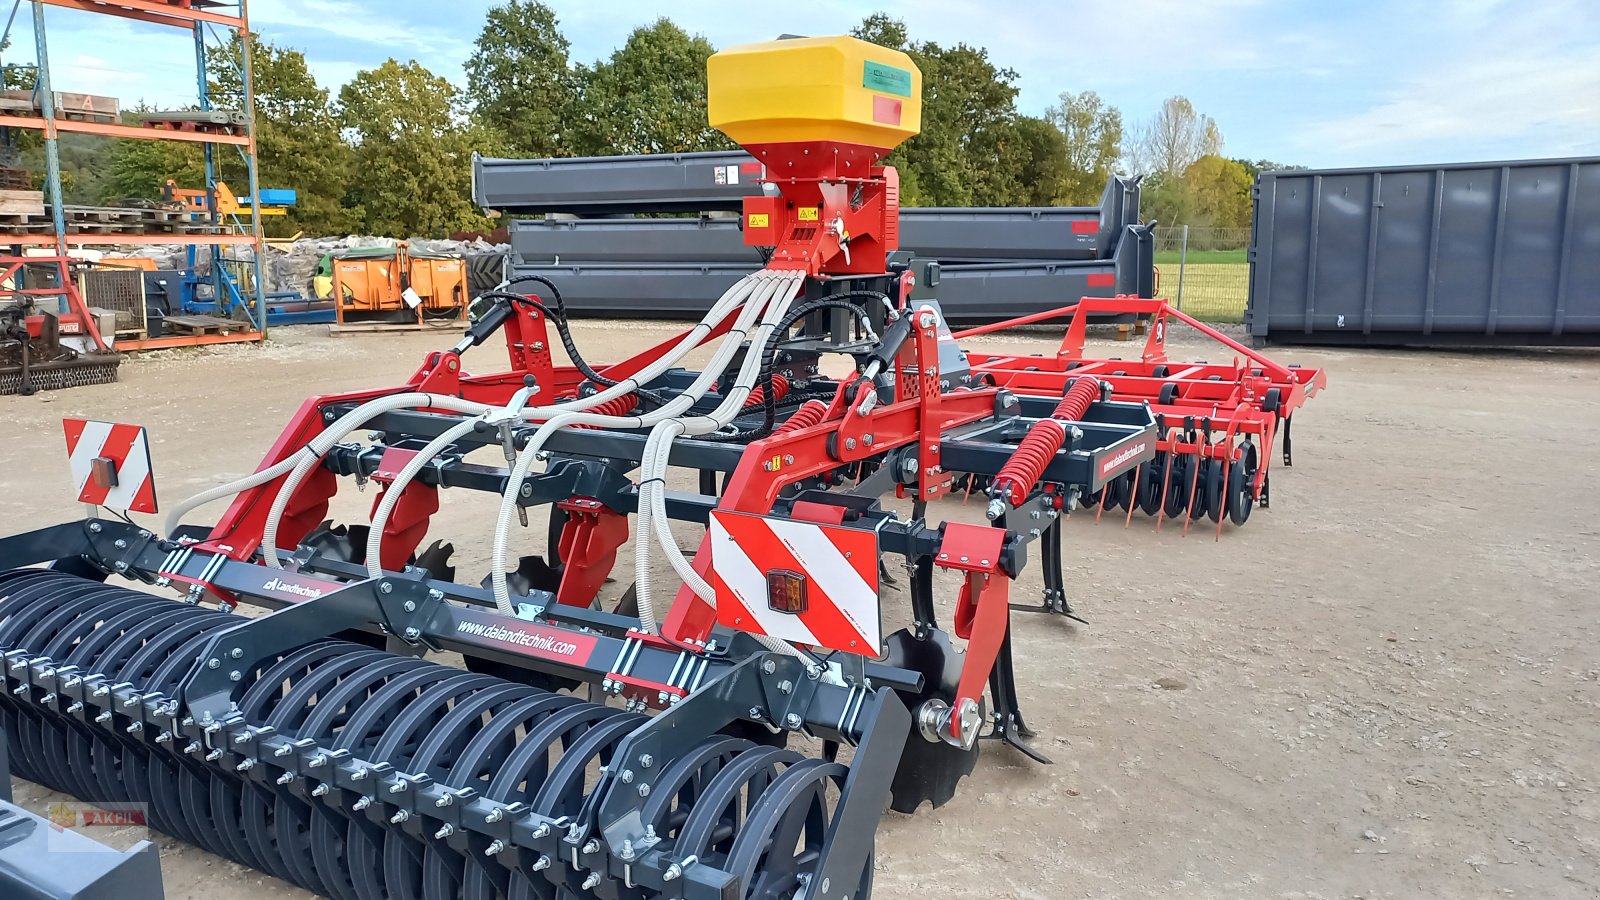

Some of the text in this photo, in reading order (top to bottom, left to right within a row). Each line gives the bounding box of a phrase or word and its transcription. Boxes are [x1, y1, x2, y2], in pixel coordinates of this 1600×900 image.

[82, 95, 93, 110] A
[276, 581, 322, 598] Landtechnik
[457, 620, 577, 656] www.dalandtechnik.com
